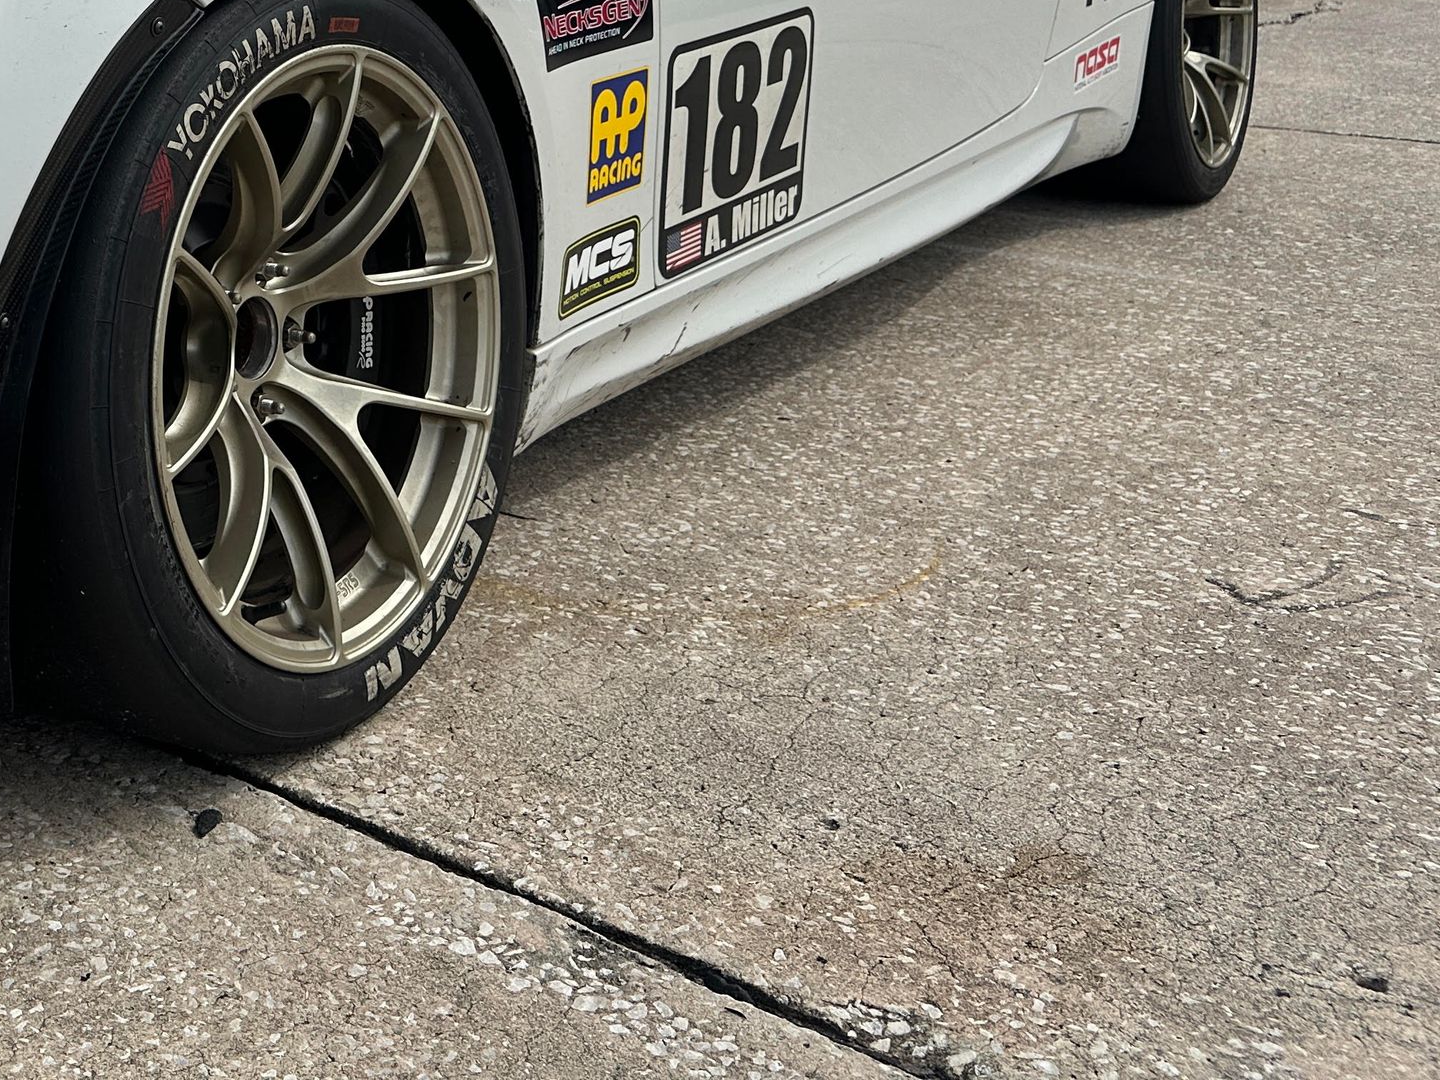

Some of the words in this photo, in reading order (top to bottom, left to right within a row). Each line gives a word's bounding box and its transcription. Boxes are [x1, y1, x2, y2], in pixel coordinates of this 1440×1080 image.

[563, 41, 569, 51] IN
[569, 39, 584, 49] NECK
[585, 27, 621, 43] PROTECTION
[167, 5, 316, 161] YOKOHAMA
[591, 80, 646, 164] AP
[674, 25, 808, 215] 182
[704, 214, 726, 256] A.
[732, 184, 798, 244] Miller
[564, 228, 635, 296] MCS
